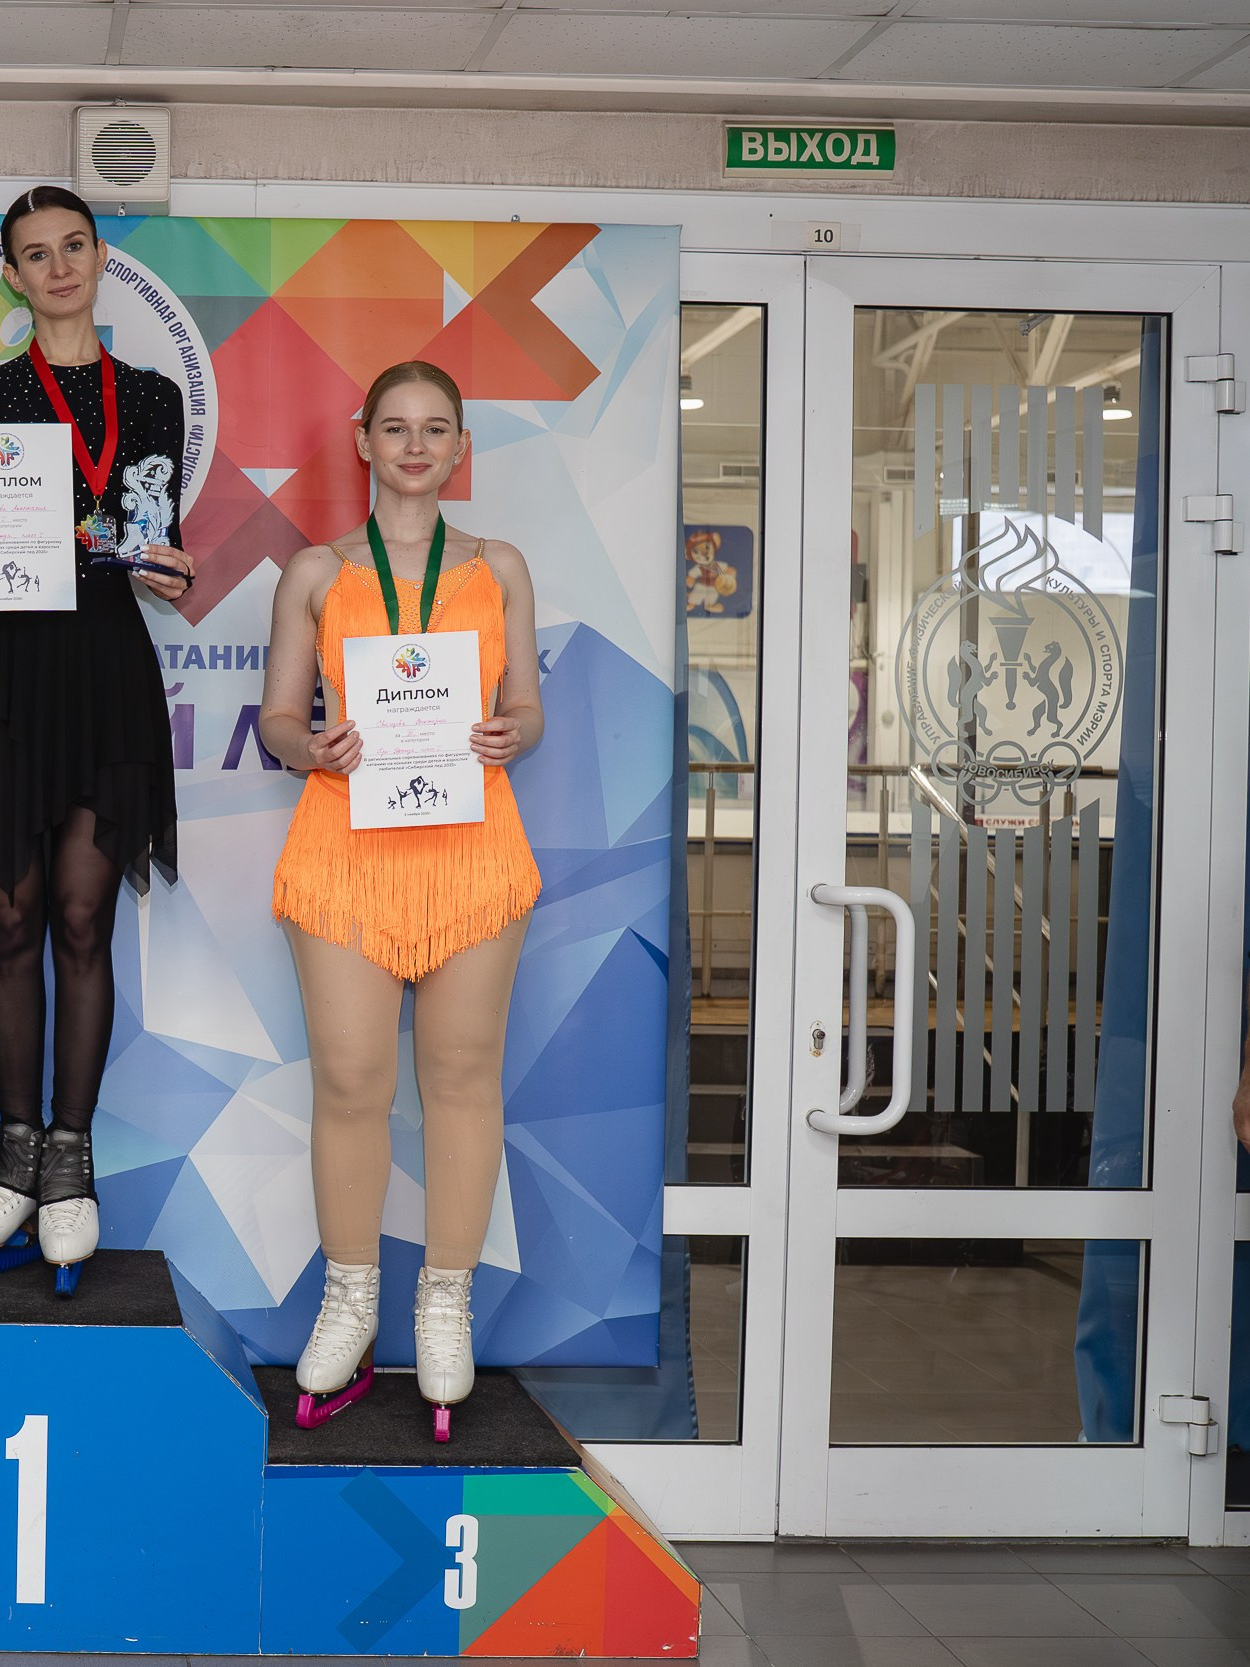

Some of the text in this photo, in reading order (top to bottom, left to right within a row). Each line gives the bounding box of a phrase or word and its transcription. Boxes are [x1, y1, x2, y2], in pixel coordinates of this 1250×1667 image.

[741, 132, 880, 166] ВЫХОД
[814, 229, 834, 243] 10
[168, 321, 207, 416] ОРГАНИЗАЦИЯ
[1045, 576, 1100, 635] КУЛЬТУРЫ
[1097, 630, 1107, 641] И
[1100, 645, 1113, 697] СПОРТА
[376, 687, 449, 705] Диплом
[386, 704, 441, 714] награждается
[906, 661, 940, 745] УПРАВЛЕНИЕ
[1077, 702, 1108, 748] МЭРИИ
[959, 759, 1058, 779] НОВОСИБИРСК
[5, 1414, 49, 1604] 1
[443, 1513, 479, 1610] 3
